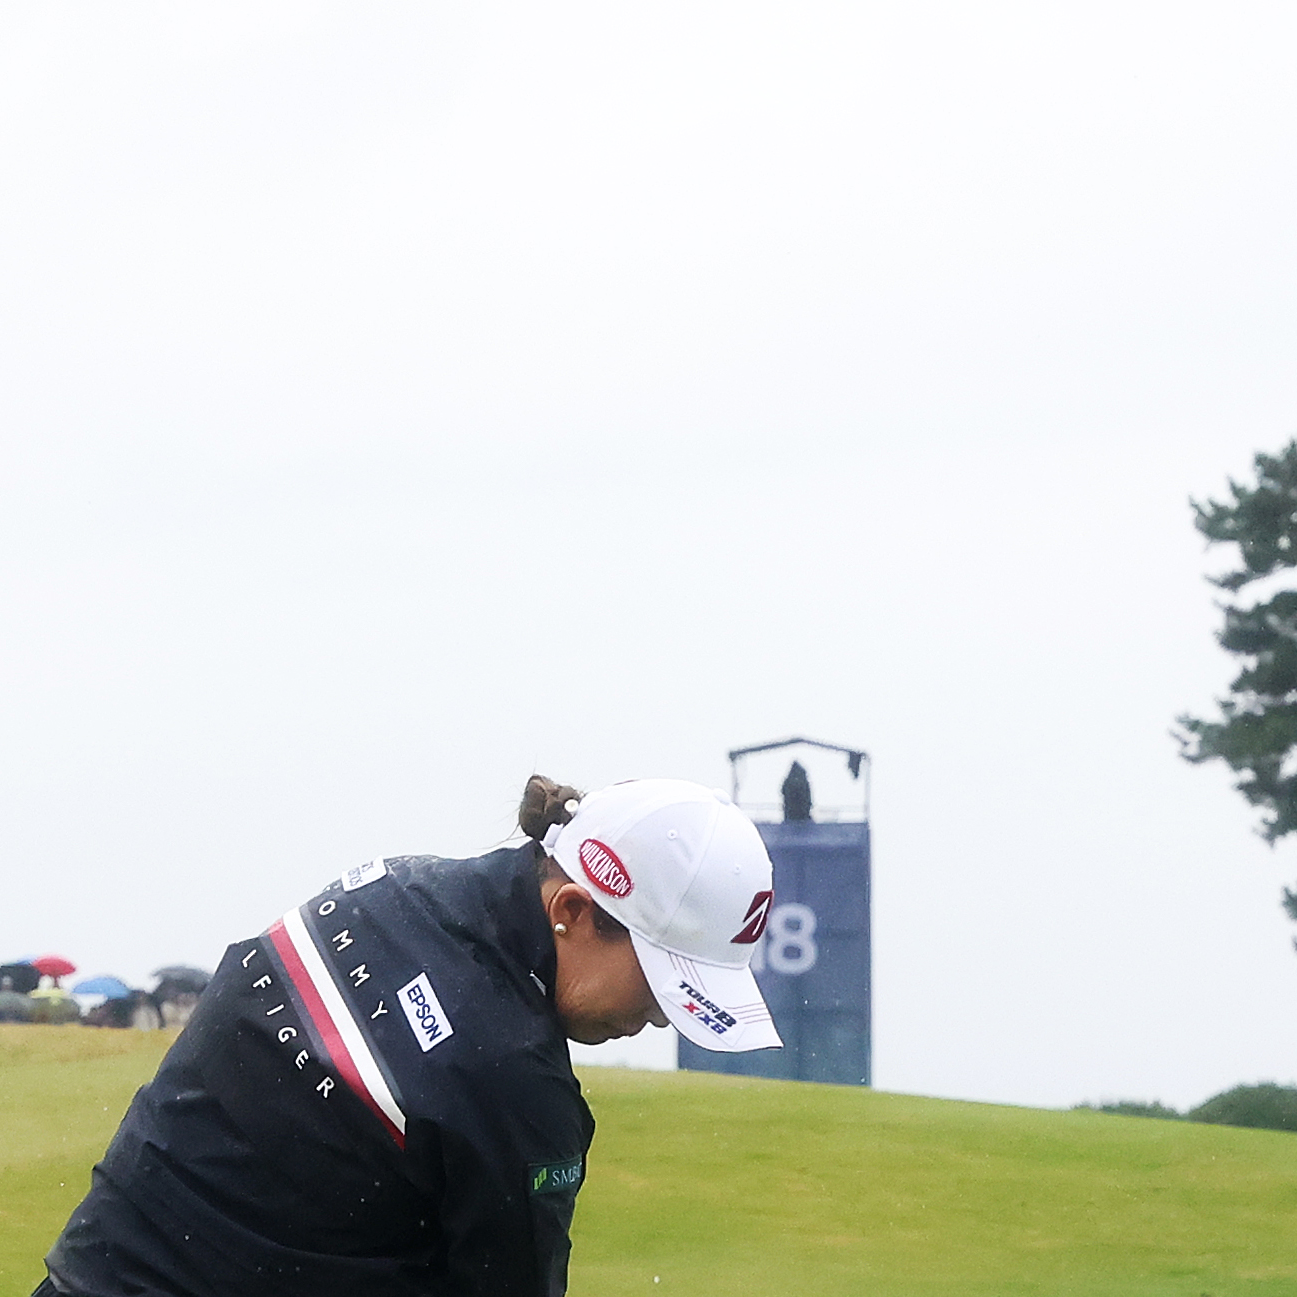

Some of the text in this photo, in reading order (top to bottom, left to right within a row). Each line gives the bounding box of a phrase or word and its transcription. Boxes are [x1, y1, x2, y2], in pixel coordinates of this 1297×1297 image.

[580, 840, 630, 895] WILKINSON
[752, 902, 818, 975] 8
[406, 983, 443, 1043] EPSON
